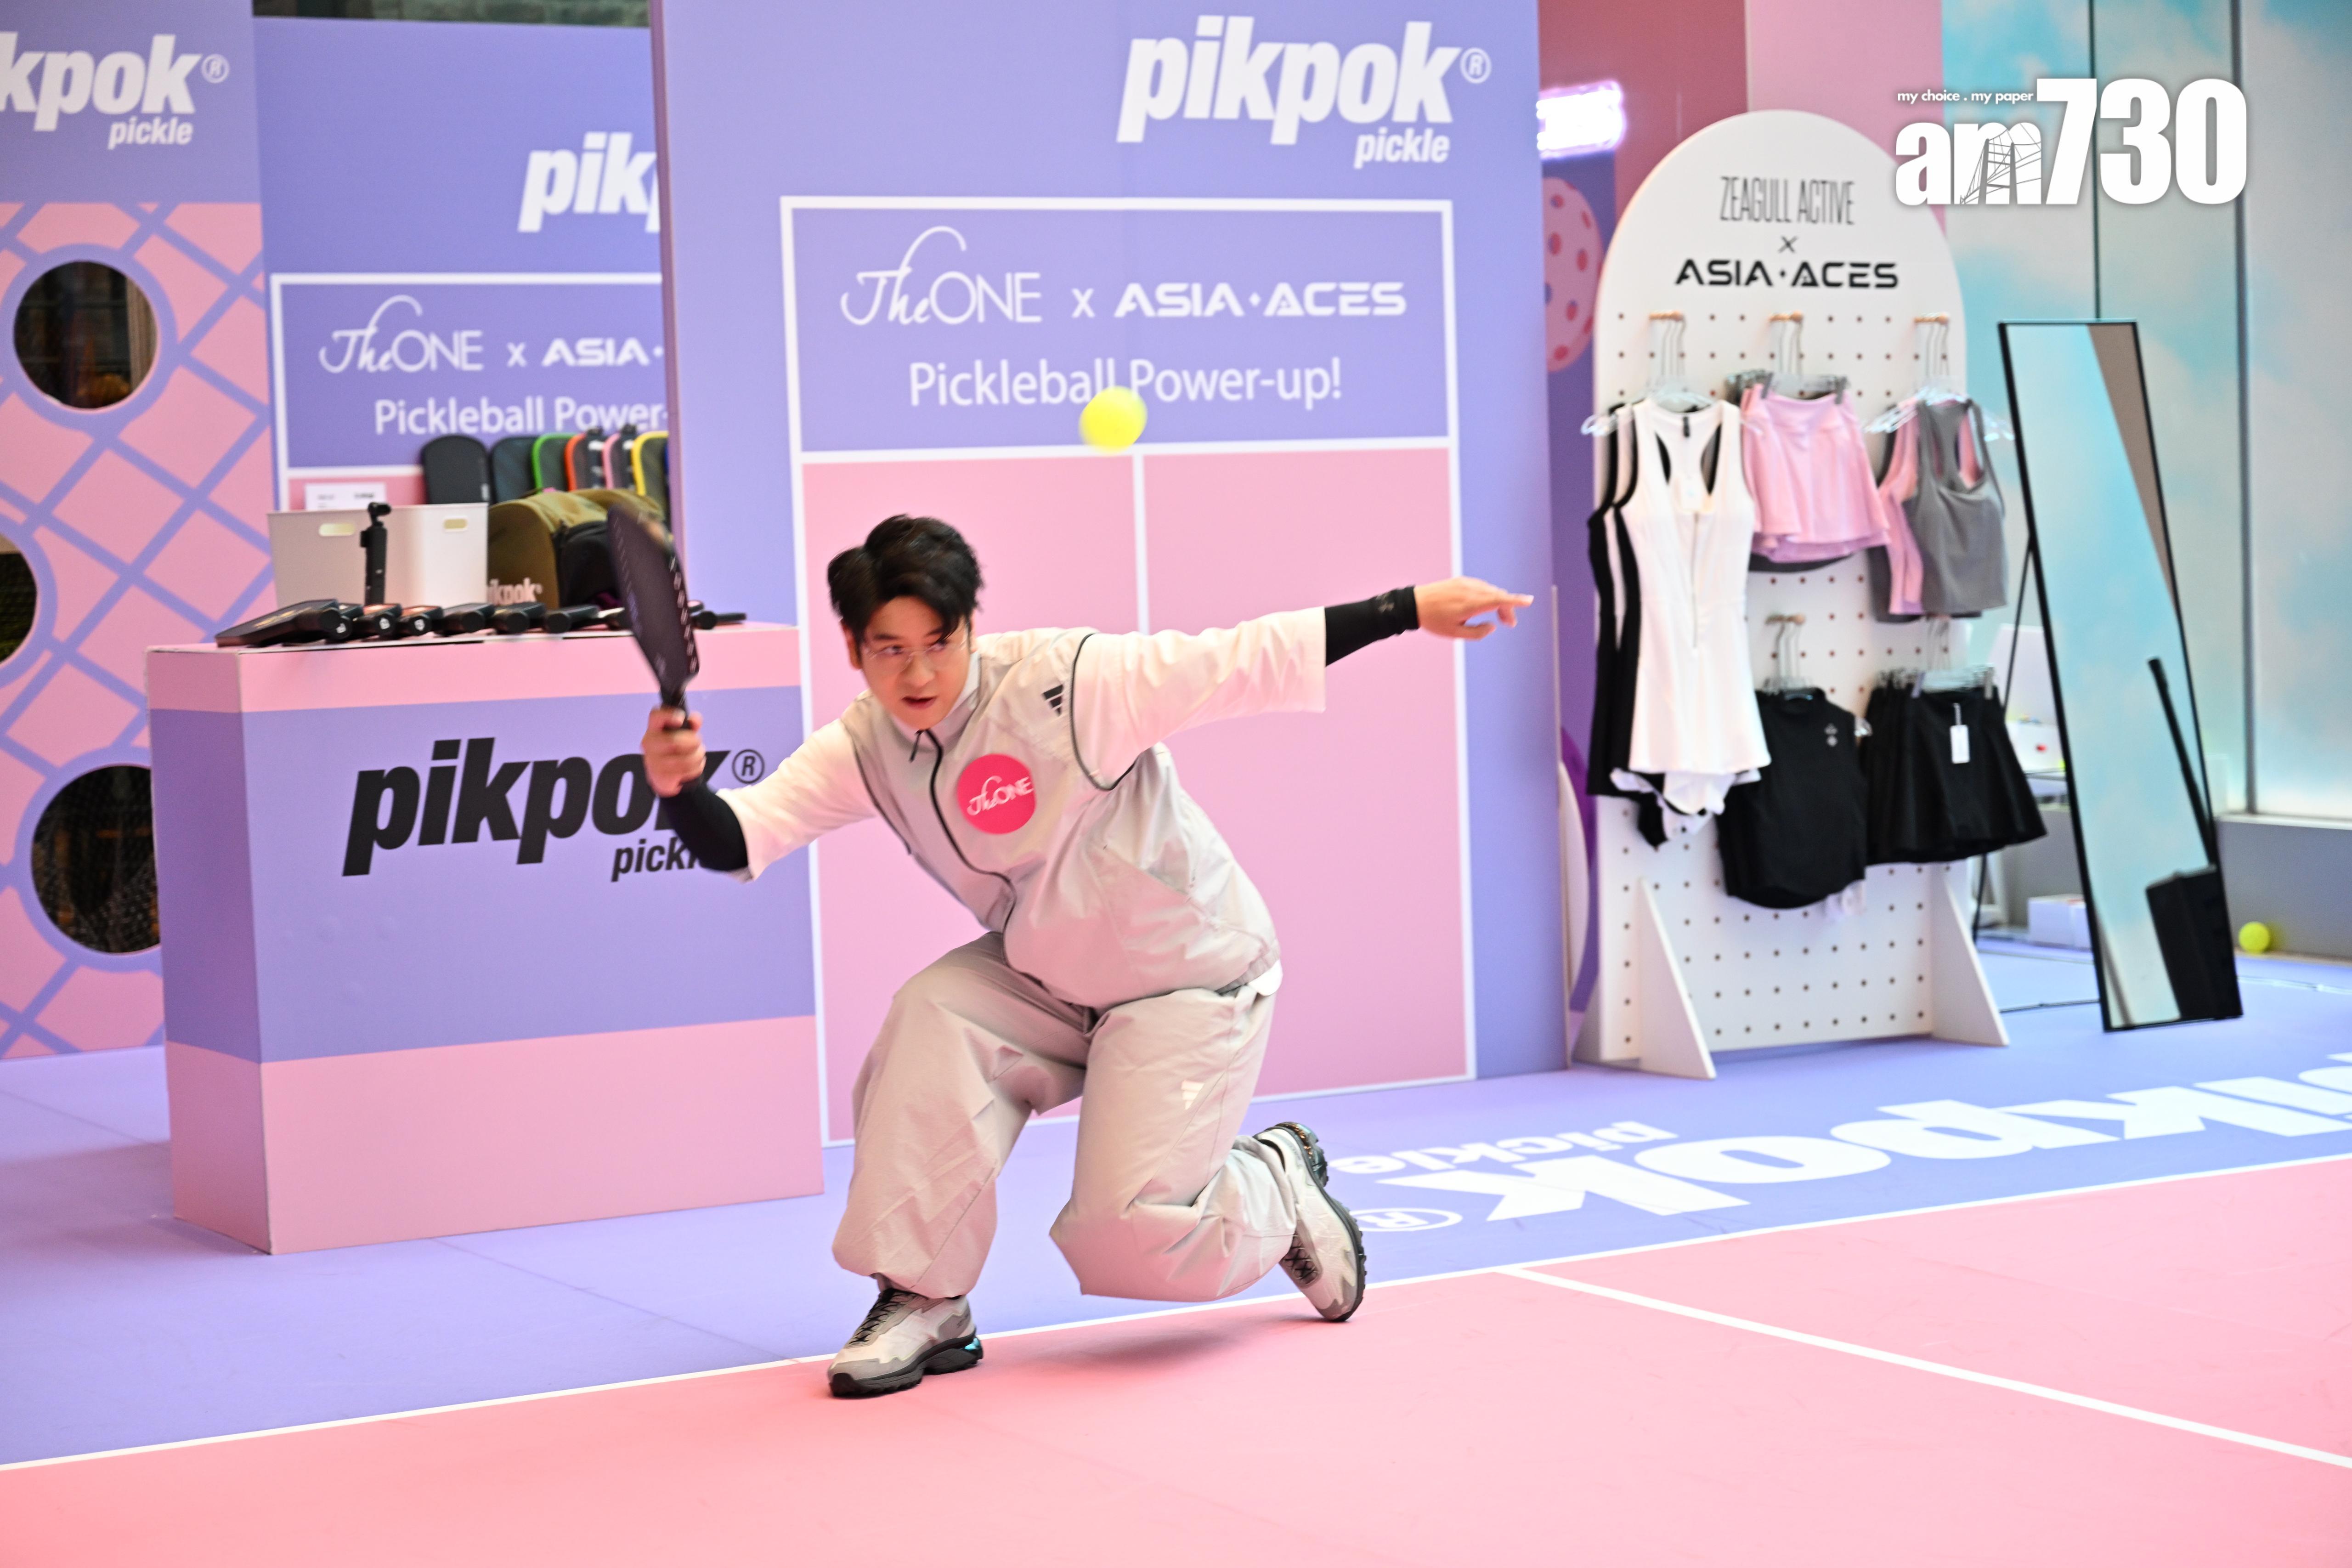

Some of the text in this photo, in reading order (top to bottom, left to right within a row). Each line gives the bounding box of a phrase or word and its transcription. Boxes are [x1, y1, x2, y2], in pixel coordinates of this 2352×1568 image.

[107, 116, 193, 150] pickle
[1354, 127, 1450, 169] pickle
[1719, 175, 1855, 225] ZEAGULL ACTIVE
[909, 357, 1342, 411] Pickleball Power-up!
[374, 396, 545, 436] Pickleball
[1329, 1121, 1679, 1174] pickle
